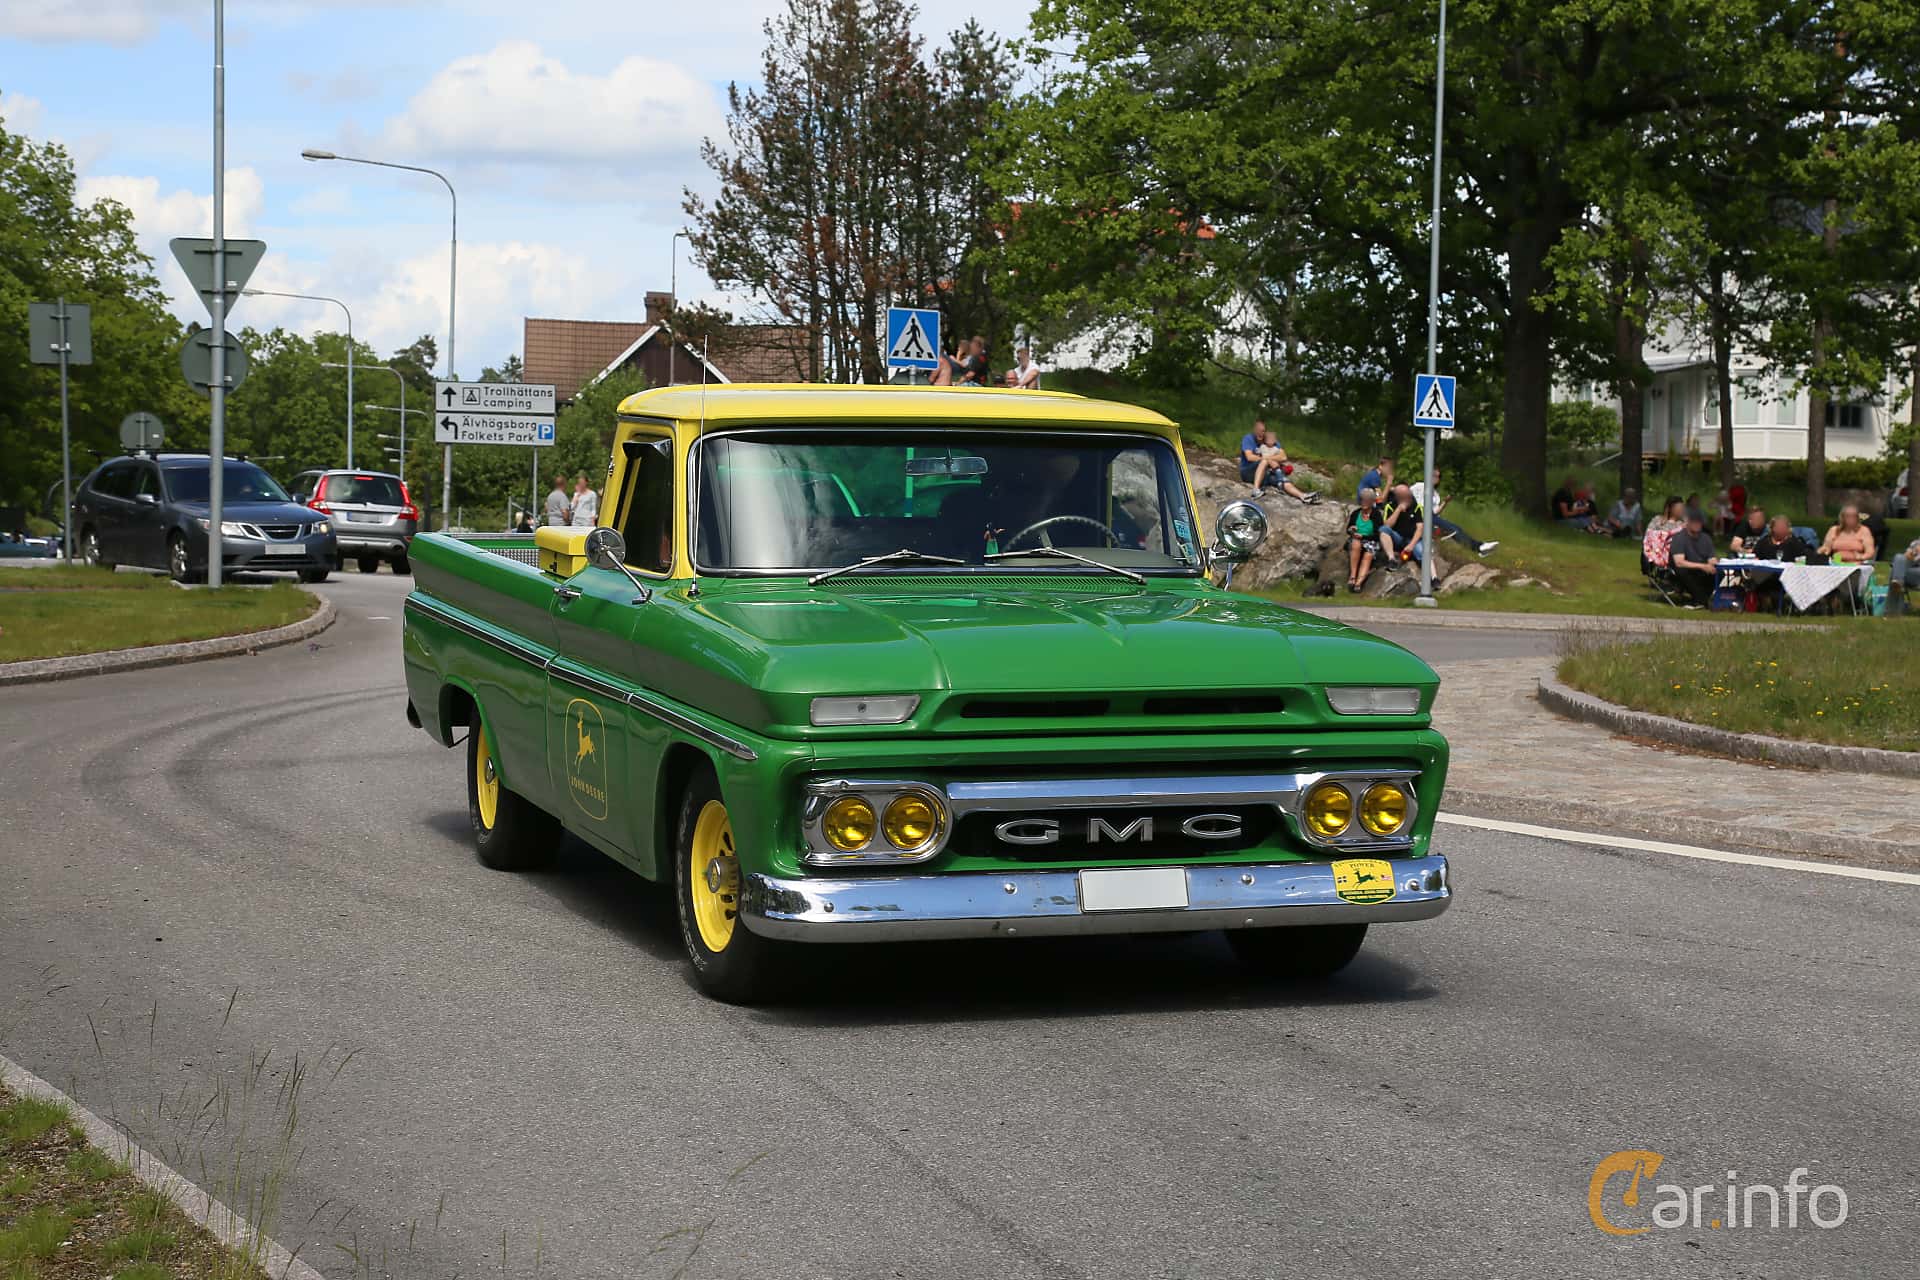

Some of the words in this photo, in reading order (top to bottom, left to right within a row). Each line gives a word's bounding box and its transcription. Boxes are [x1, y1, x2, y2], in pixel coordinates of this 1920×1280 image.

[484, 387, 553, 398] Trollhättans
[483, 398, 532, 409] camping
[462, 416, 537, 431] Älvhögsborg
[462, 431, 504, 441] Folkets
[508, 432, 535, 441] Park
[995, 813, 1242, 845] GMC
